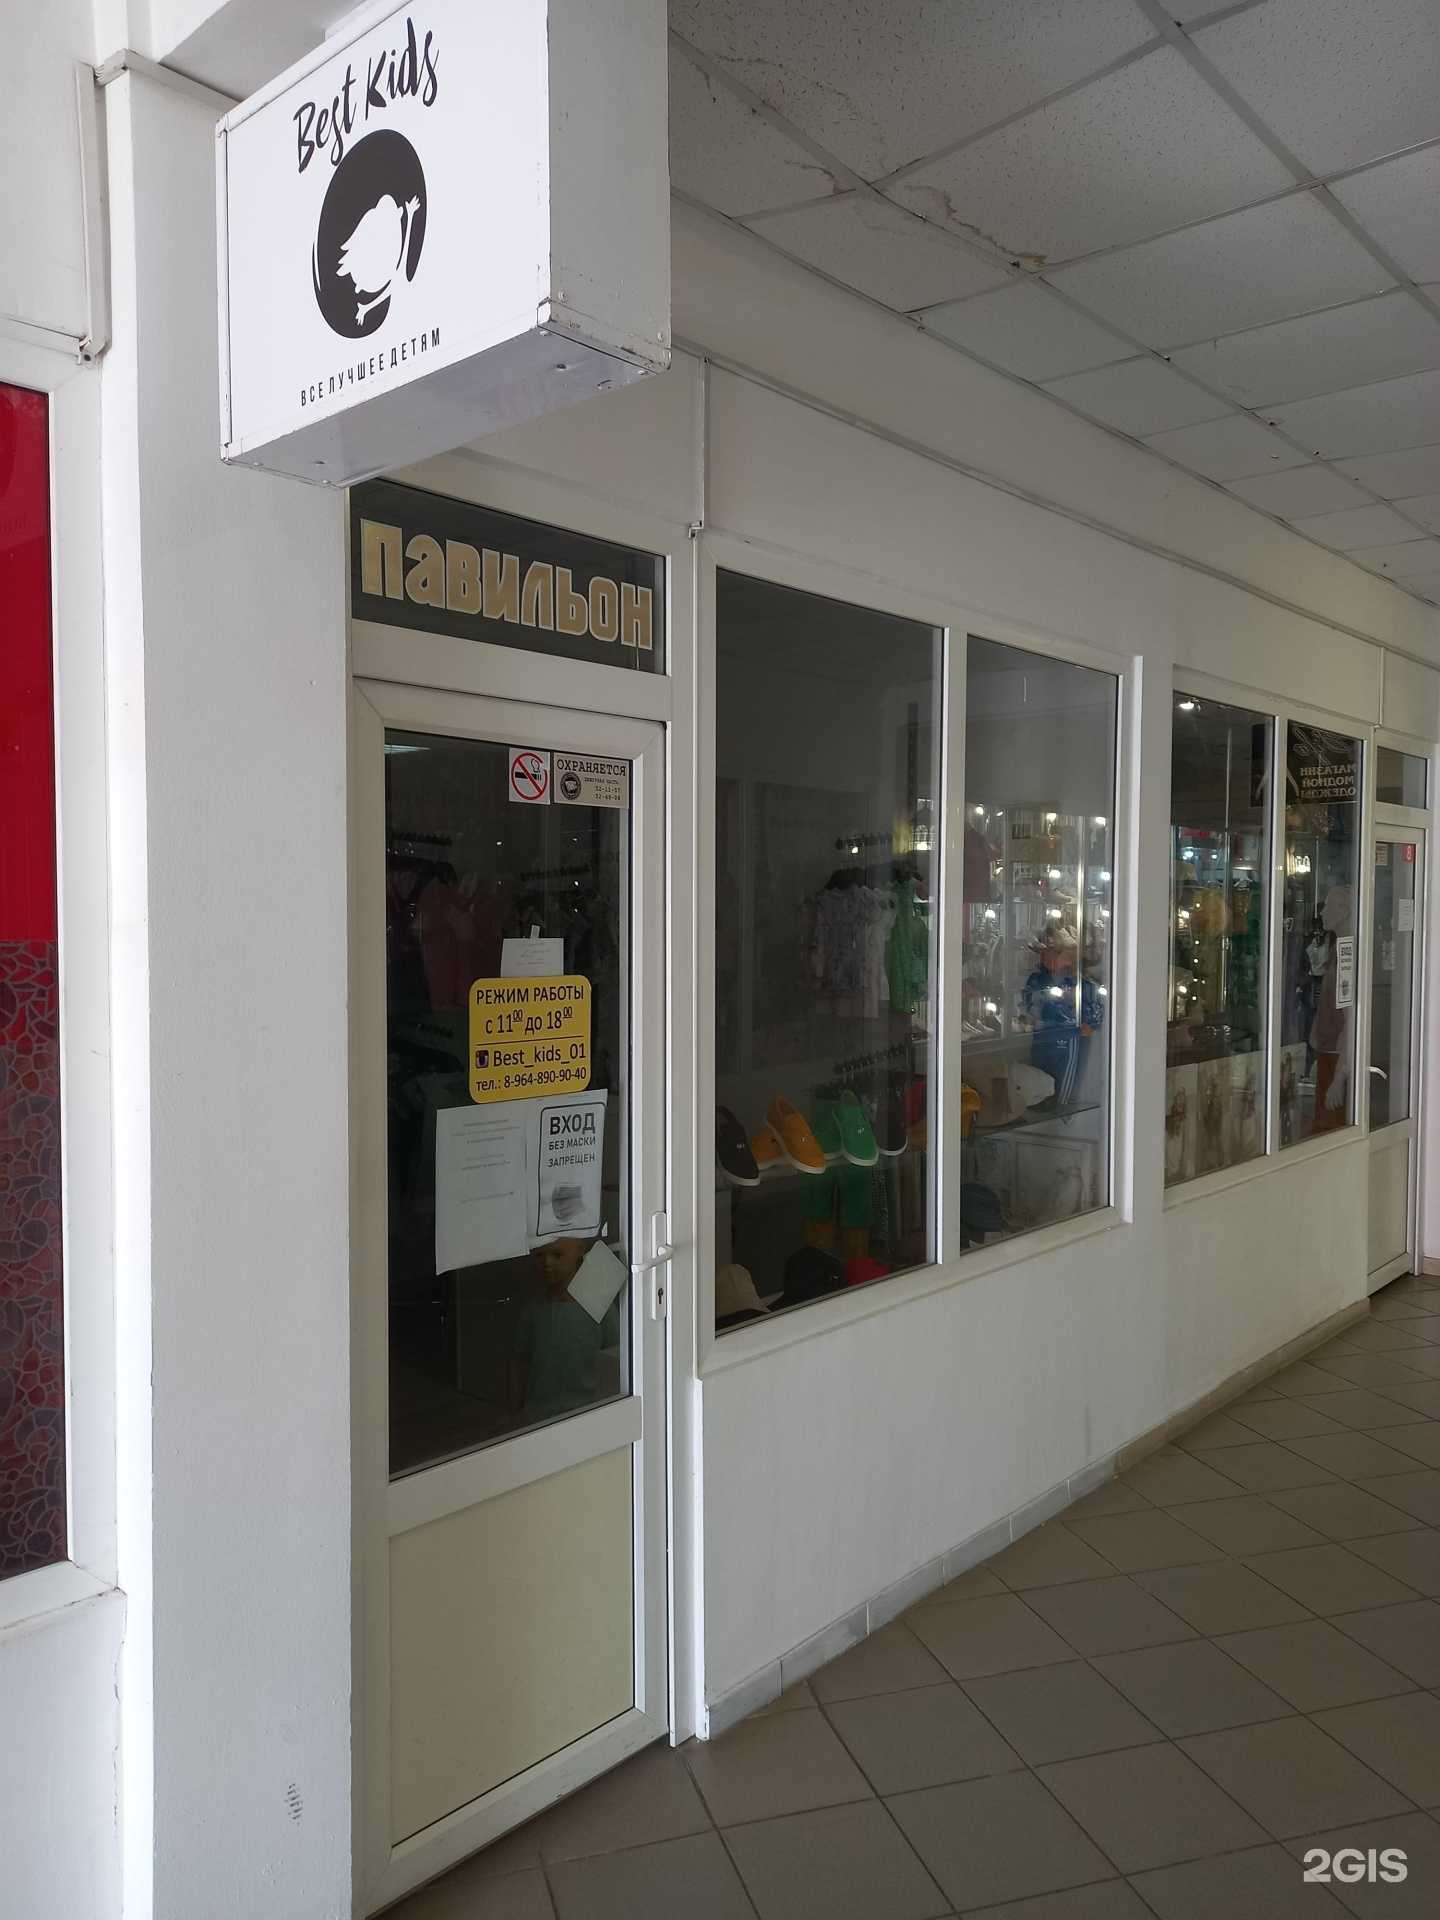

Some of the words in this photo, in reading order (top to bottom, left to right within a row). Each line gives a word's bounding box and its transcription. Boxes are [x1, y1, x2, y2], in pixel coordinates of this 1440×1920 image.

[293, 63, 357, 174] Best
[365, 17, 440, 121] Kids
[301, 381, 324, 407] ВСЕ
[328, 352, 385, 395] ЛУЧШЕЕ
[390, 327, 440, 369] ДЕТЯМ
[556, 758, 627, 777] ОХРАНЯЕТСЯ
[476, 987, 529, 1005] РЕЖИМ
[533, 985, 584, 1002] РАБОТЫ
[525, 1016, 543, 1035] до
[493, 1043, 586, 1068] Best_kids_01
[504, 1066, 587, 1089] 8-964-890-90-40
[550, 1112, 596, 1136] ВХОД
[548, 1140, 565, 1151] БЕЗ
[566, 1136, 596, 1149] МАСКИ
[548, 1153, 596, 1168] ЗАПРЕЩЕН
